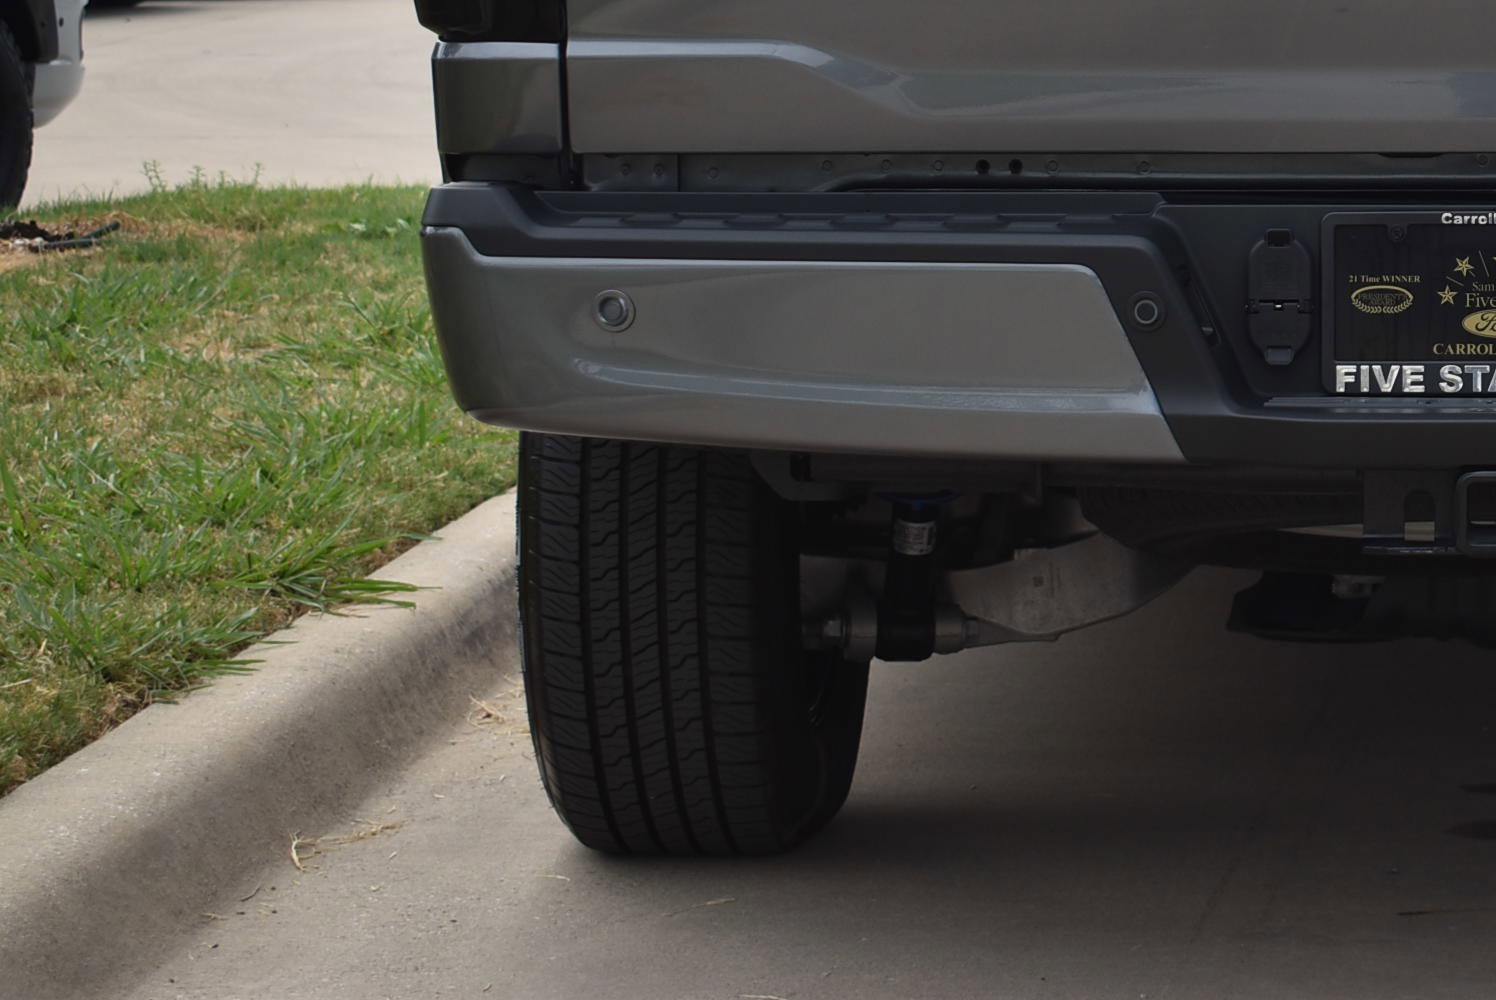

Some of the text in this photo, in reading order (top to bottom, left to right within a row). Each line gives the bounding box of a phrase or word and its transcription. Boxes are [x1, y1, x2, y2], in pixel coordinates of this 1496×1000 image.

[1348, 274, 1421, 283] 21 Time WINNER
[1472, 281, 1495, 292] Sam
[1335, 364, 1426, 394] FIVE
